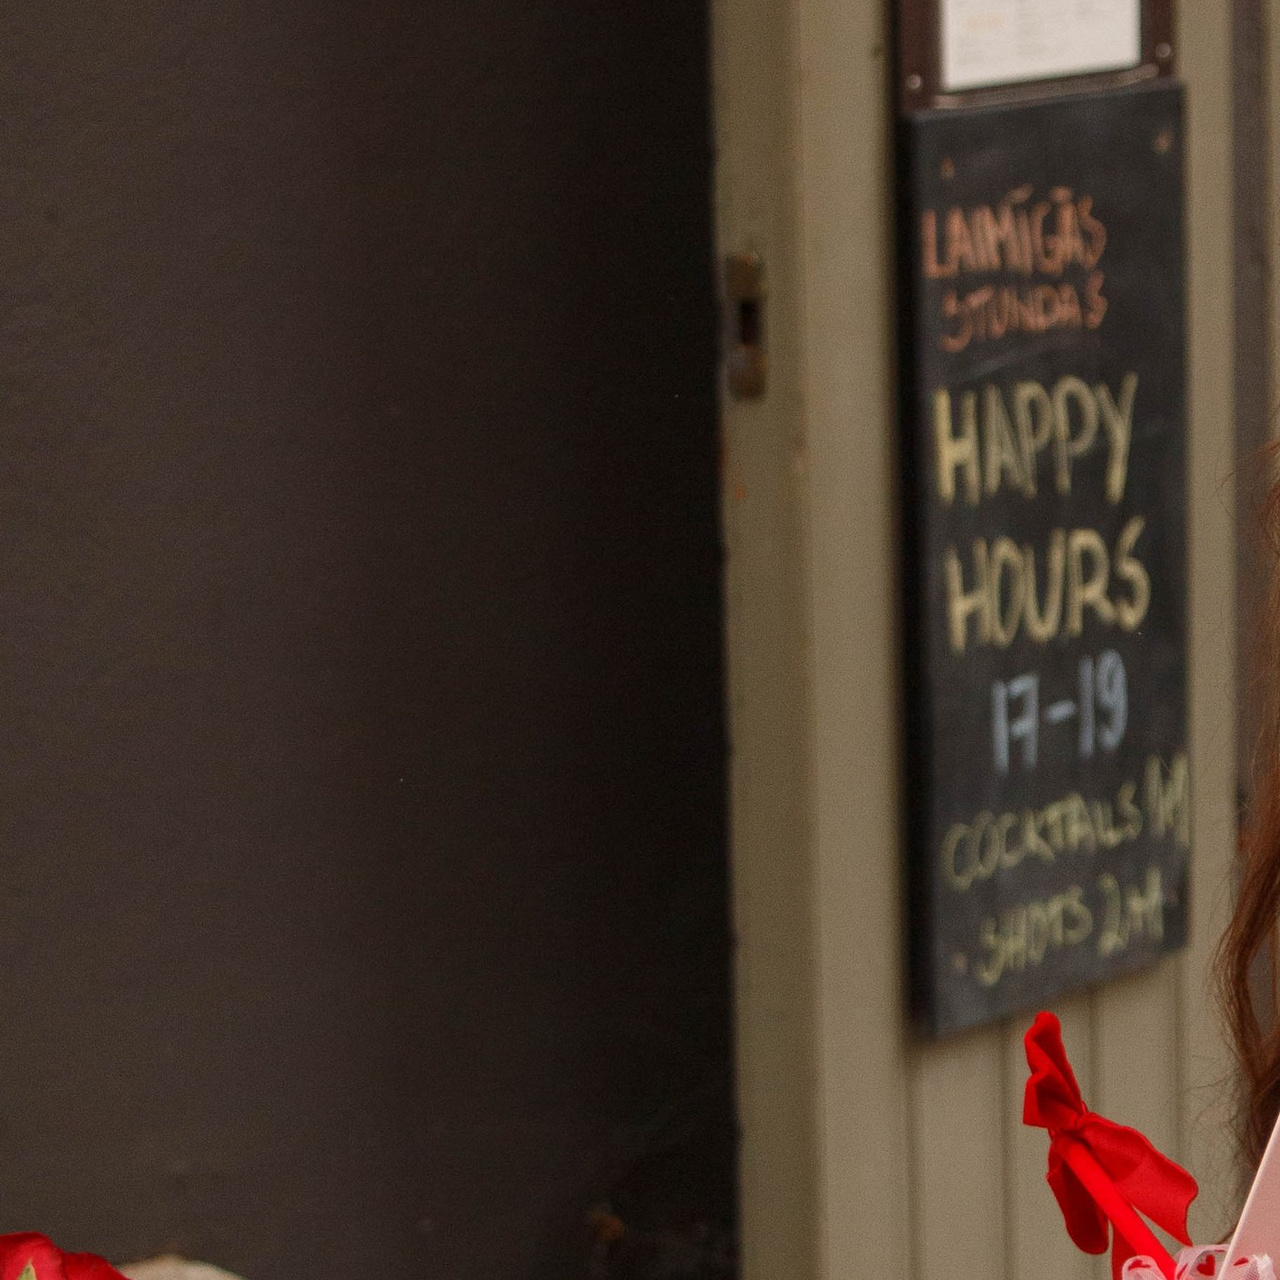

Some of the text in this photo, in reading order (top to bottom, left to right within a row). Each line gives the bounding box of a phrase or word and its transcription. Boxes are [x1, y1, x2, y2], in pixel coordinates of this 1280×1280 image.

[933, 371, 1139, 506] HAPPY
[945, 518, 1151, 654] HOURS
[992, 649, 1129, 773] 17-19
